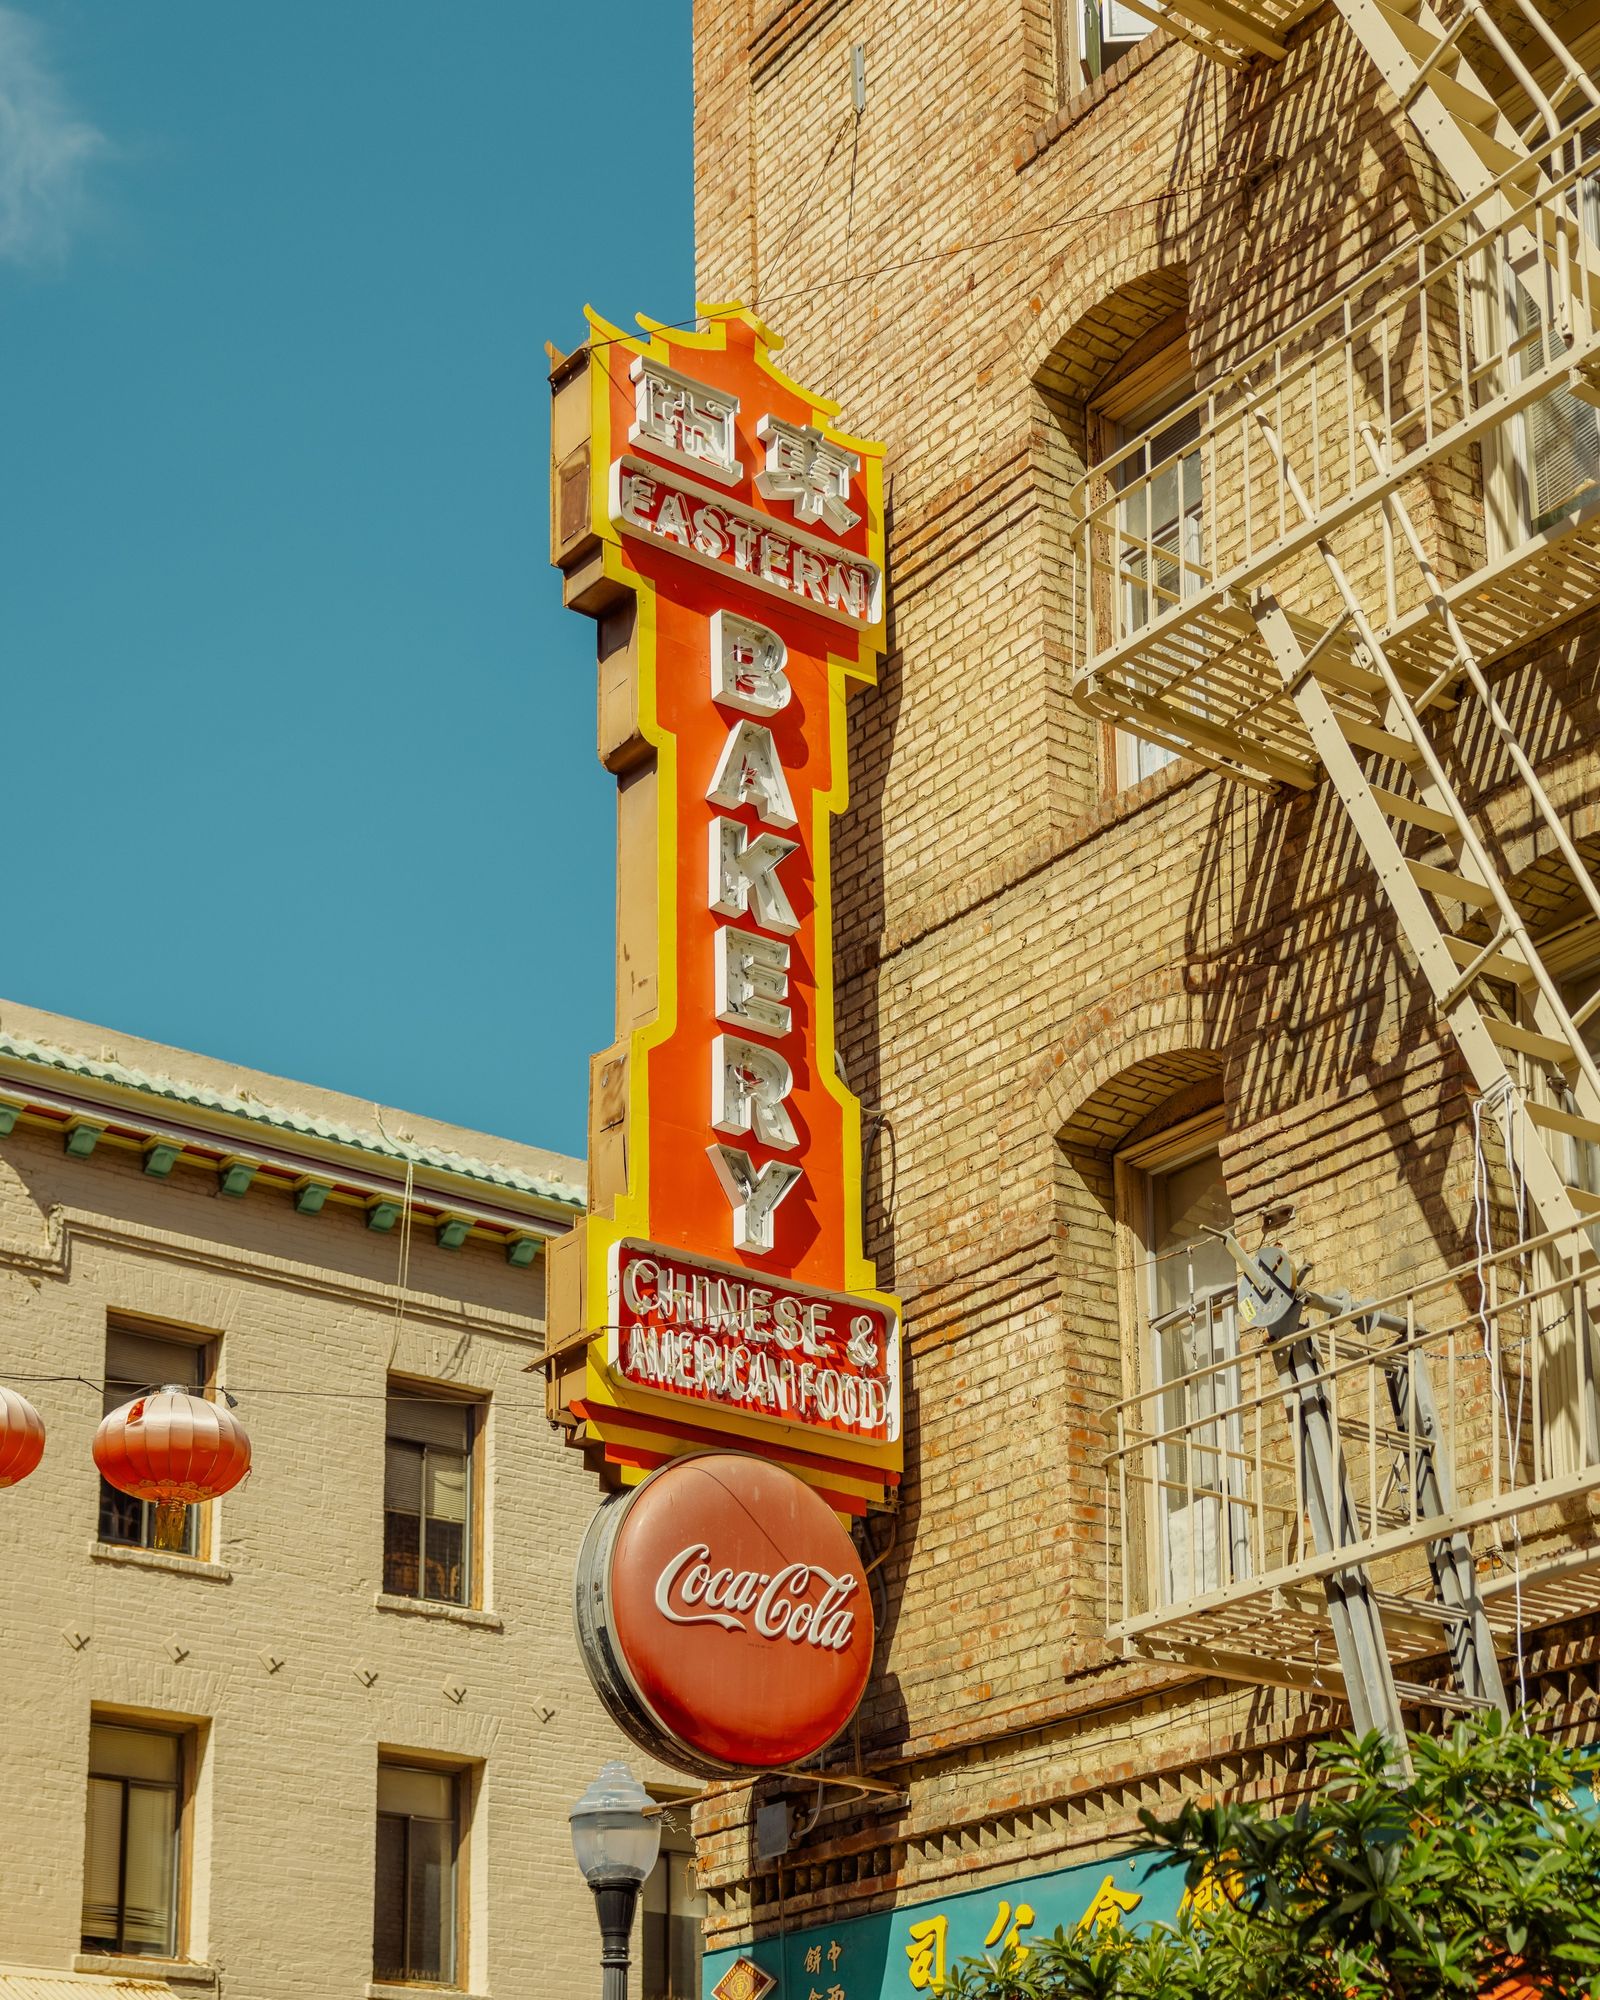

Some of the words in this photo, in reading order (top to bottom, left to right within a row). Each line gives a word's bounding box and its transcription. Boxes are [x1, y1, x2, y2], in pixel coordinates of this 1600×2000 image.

[622, 474, 866, 620] EASTERN
[704, 608, 803, 1256] BAKERY
[622, 1258, 836, 1358] CHINESE
[847, 1314, 878, 1369] &
[627, 1322, 797, 1411] AMERICAN
[798, 1361, 888, 1429] FOOD
[655, 1543, 858, 1650] Coca-Cola
